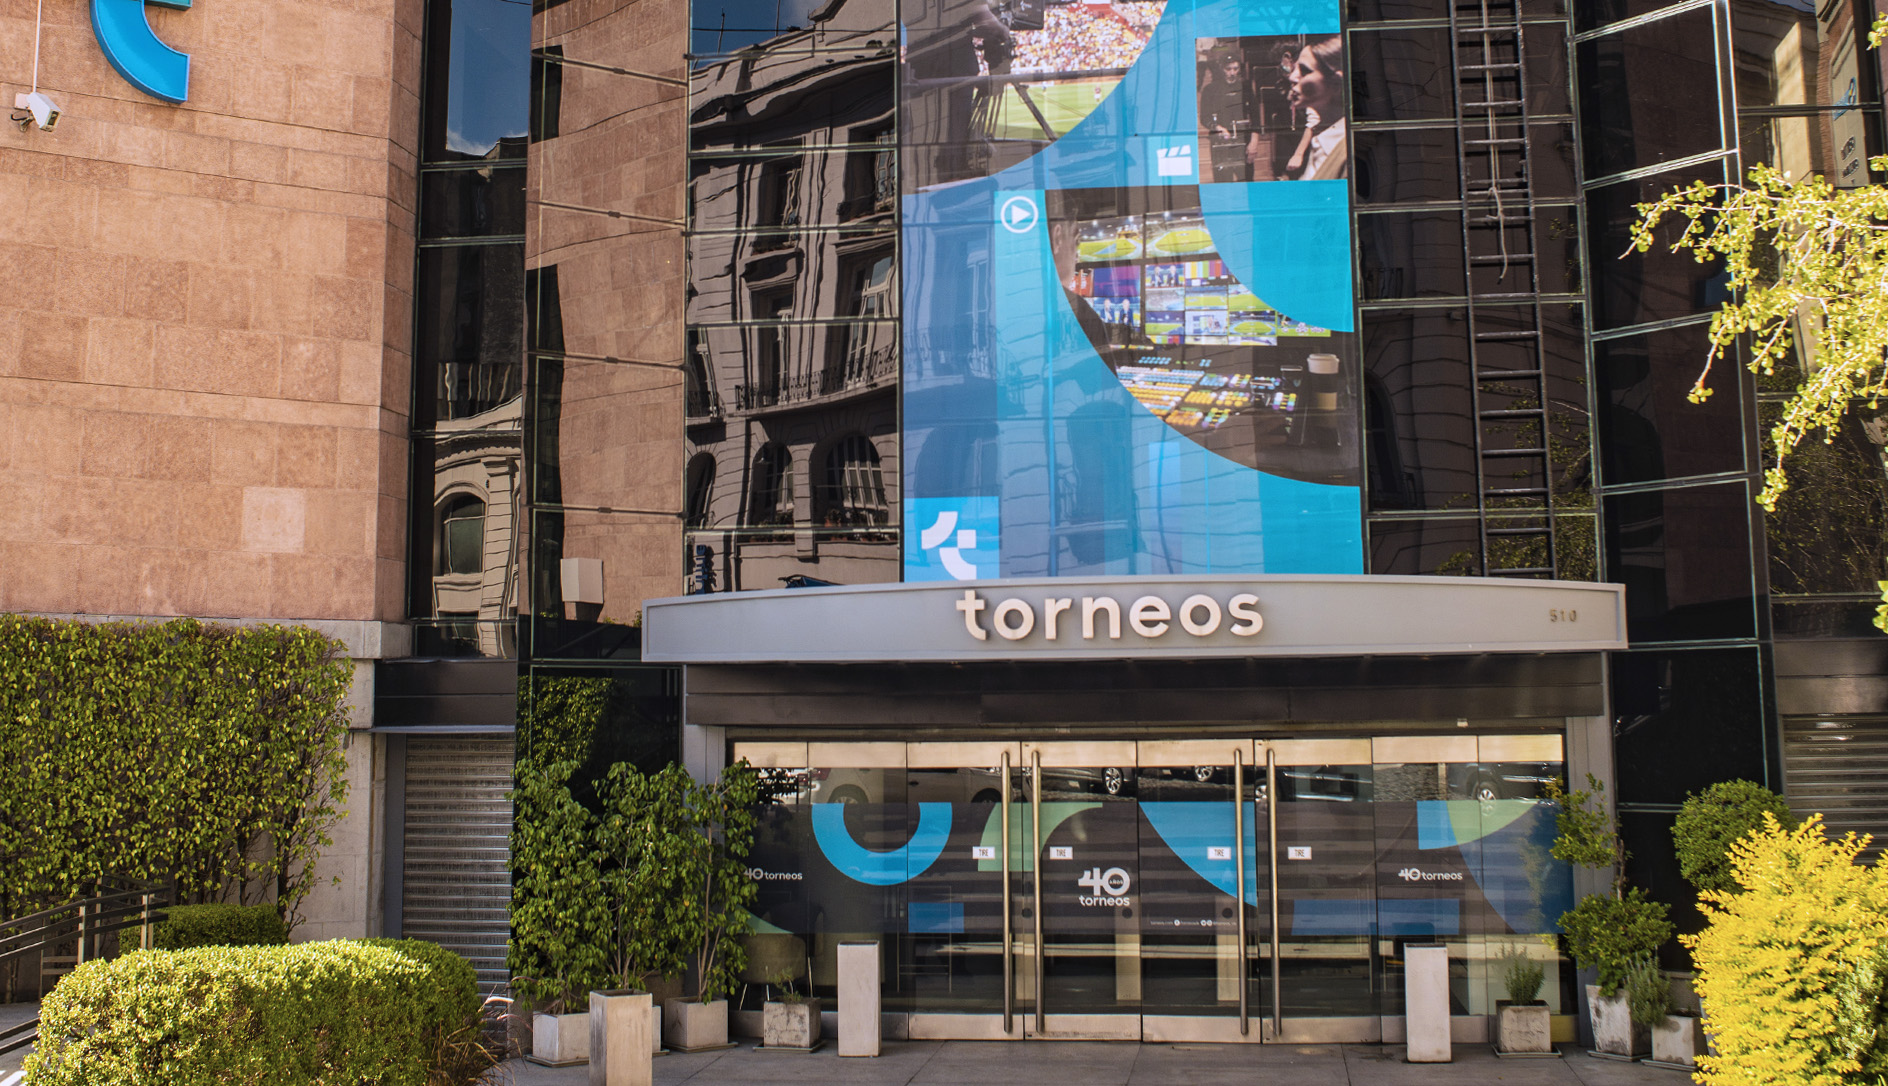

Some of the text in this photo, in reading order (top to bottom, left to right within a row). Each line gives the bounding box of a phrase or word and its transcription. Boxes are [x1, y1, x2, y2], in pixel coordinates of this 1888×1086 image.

[955, 589, 1264, 641] torneos
[1549, 608, 1577, 622] 510
[978, 848, 989, 857] TIRE
[1055, 848, 1066, 857] TIRE
[1214, 848, 1224, 857] TIRE
[1294, 849, 1305, 857] TIRE
[764, 871, 803, 880] torneos
[1398, 867, 1463, 881] 40 torneos
[1077, 867, 1131, 896] 40
[1078, 895, 1131, 907] torneos
